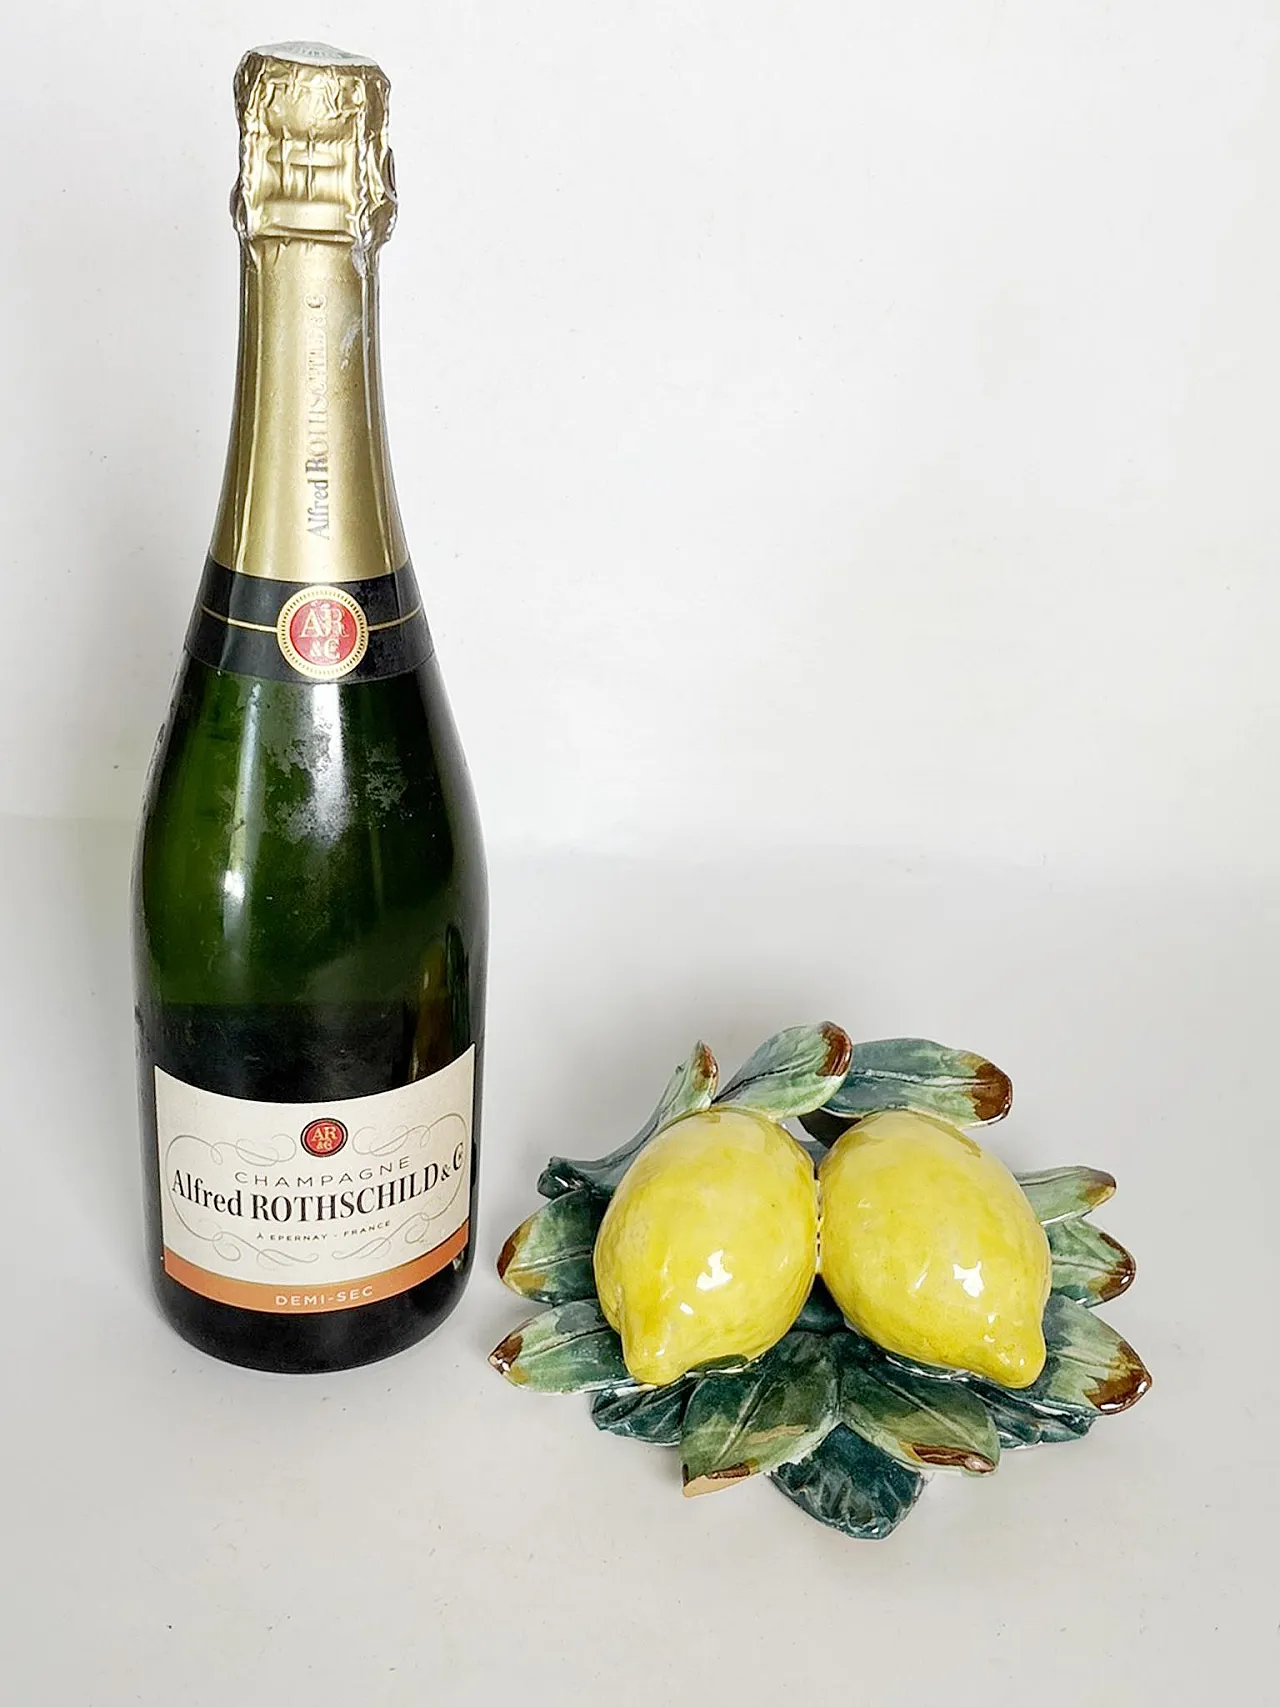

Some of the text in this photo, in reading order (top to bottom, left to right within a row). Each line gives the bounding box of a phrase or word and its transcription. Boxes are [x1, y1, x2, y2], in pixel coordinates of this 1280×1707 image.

[306, 478, 329, 539] Alfred
[311, 1126, 338, 1142] AR
[234, 1155, 410, 1188] CHAMPAGNE
[172, 1169, 244, 1217] Alfred
[343, 1220, 391, 1237] FRANCE
[275, 1285, 374, 1306] DEMI-SEC
